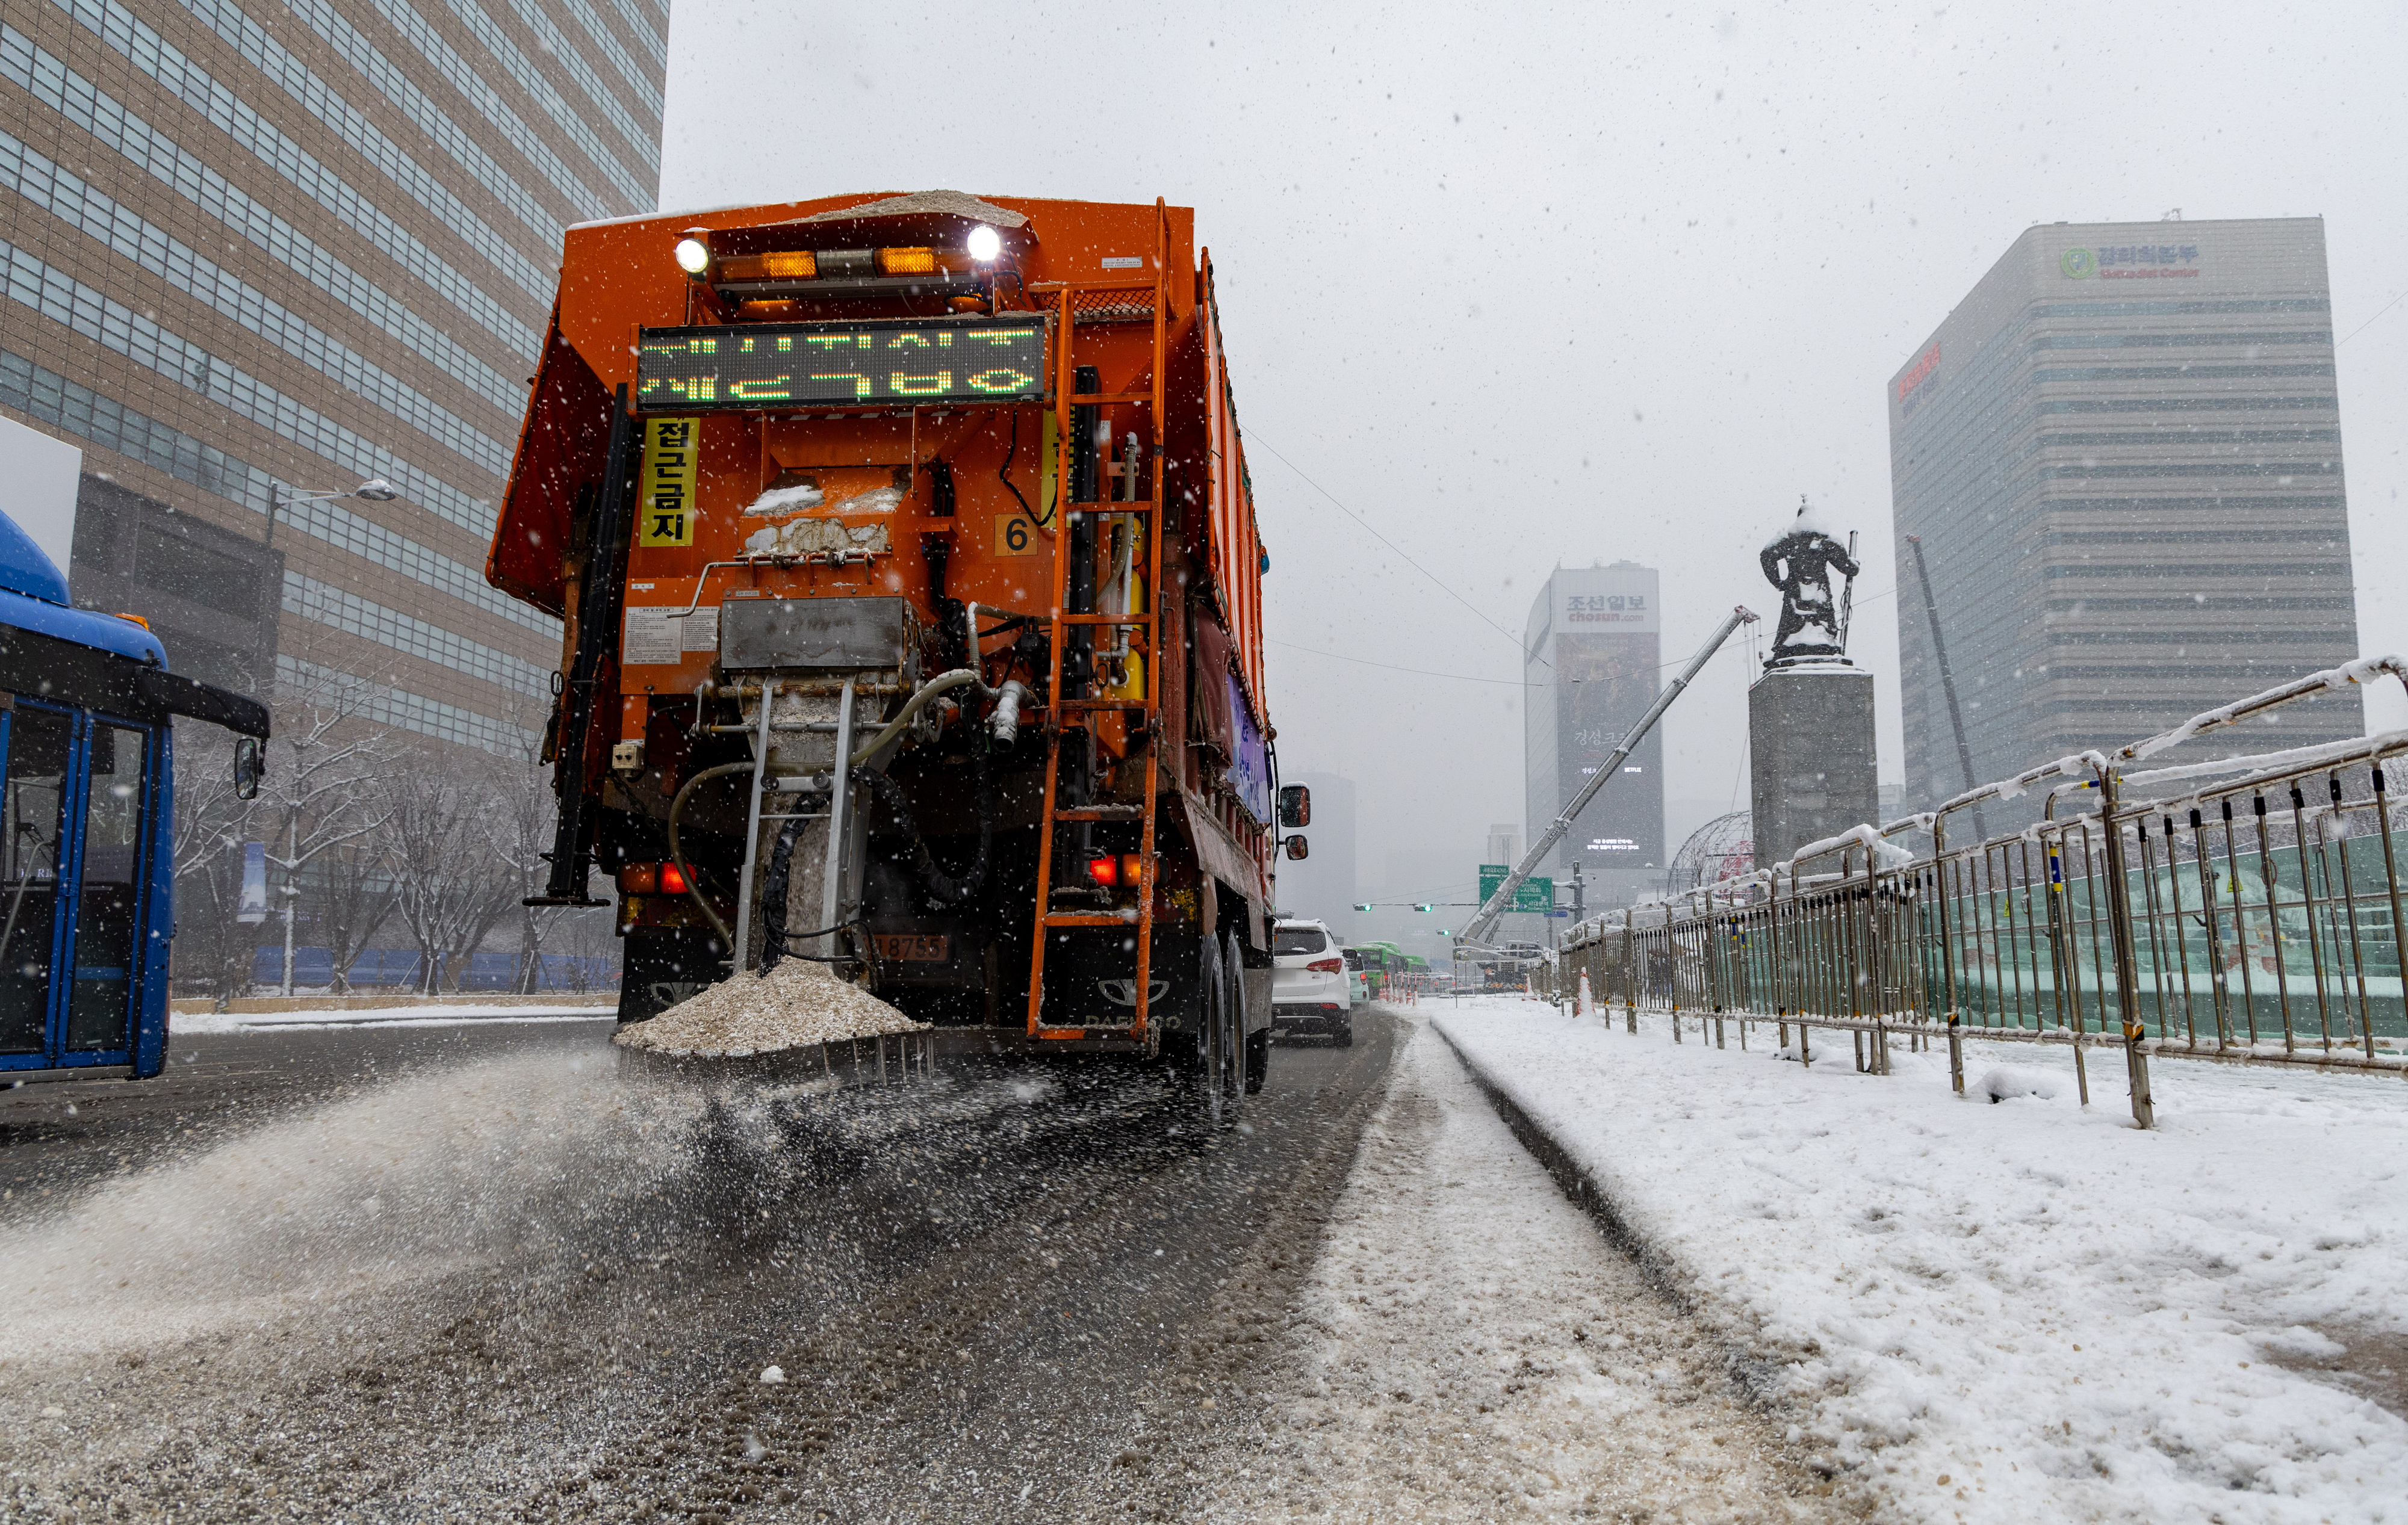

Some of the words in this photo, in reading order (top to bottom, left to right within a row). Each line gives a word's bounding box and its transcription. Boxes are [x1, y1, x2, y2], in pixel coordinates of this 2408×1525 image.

[651, 422, 690, 540] 접근금지
[1006, 518, 1028, 551] 6
[1566, 595, 1647, 611] 조선일보
[1569, 611, 1644, 622] chosun.com
[1574, 729, 1646, 746] 경성크
[888, 938, 940, 958] 8755
[1085, 1015, 1181, 1029] DAEOO
